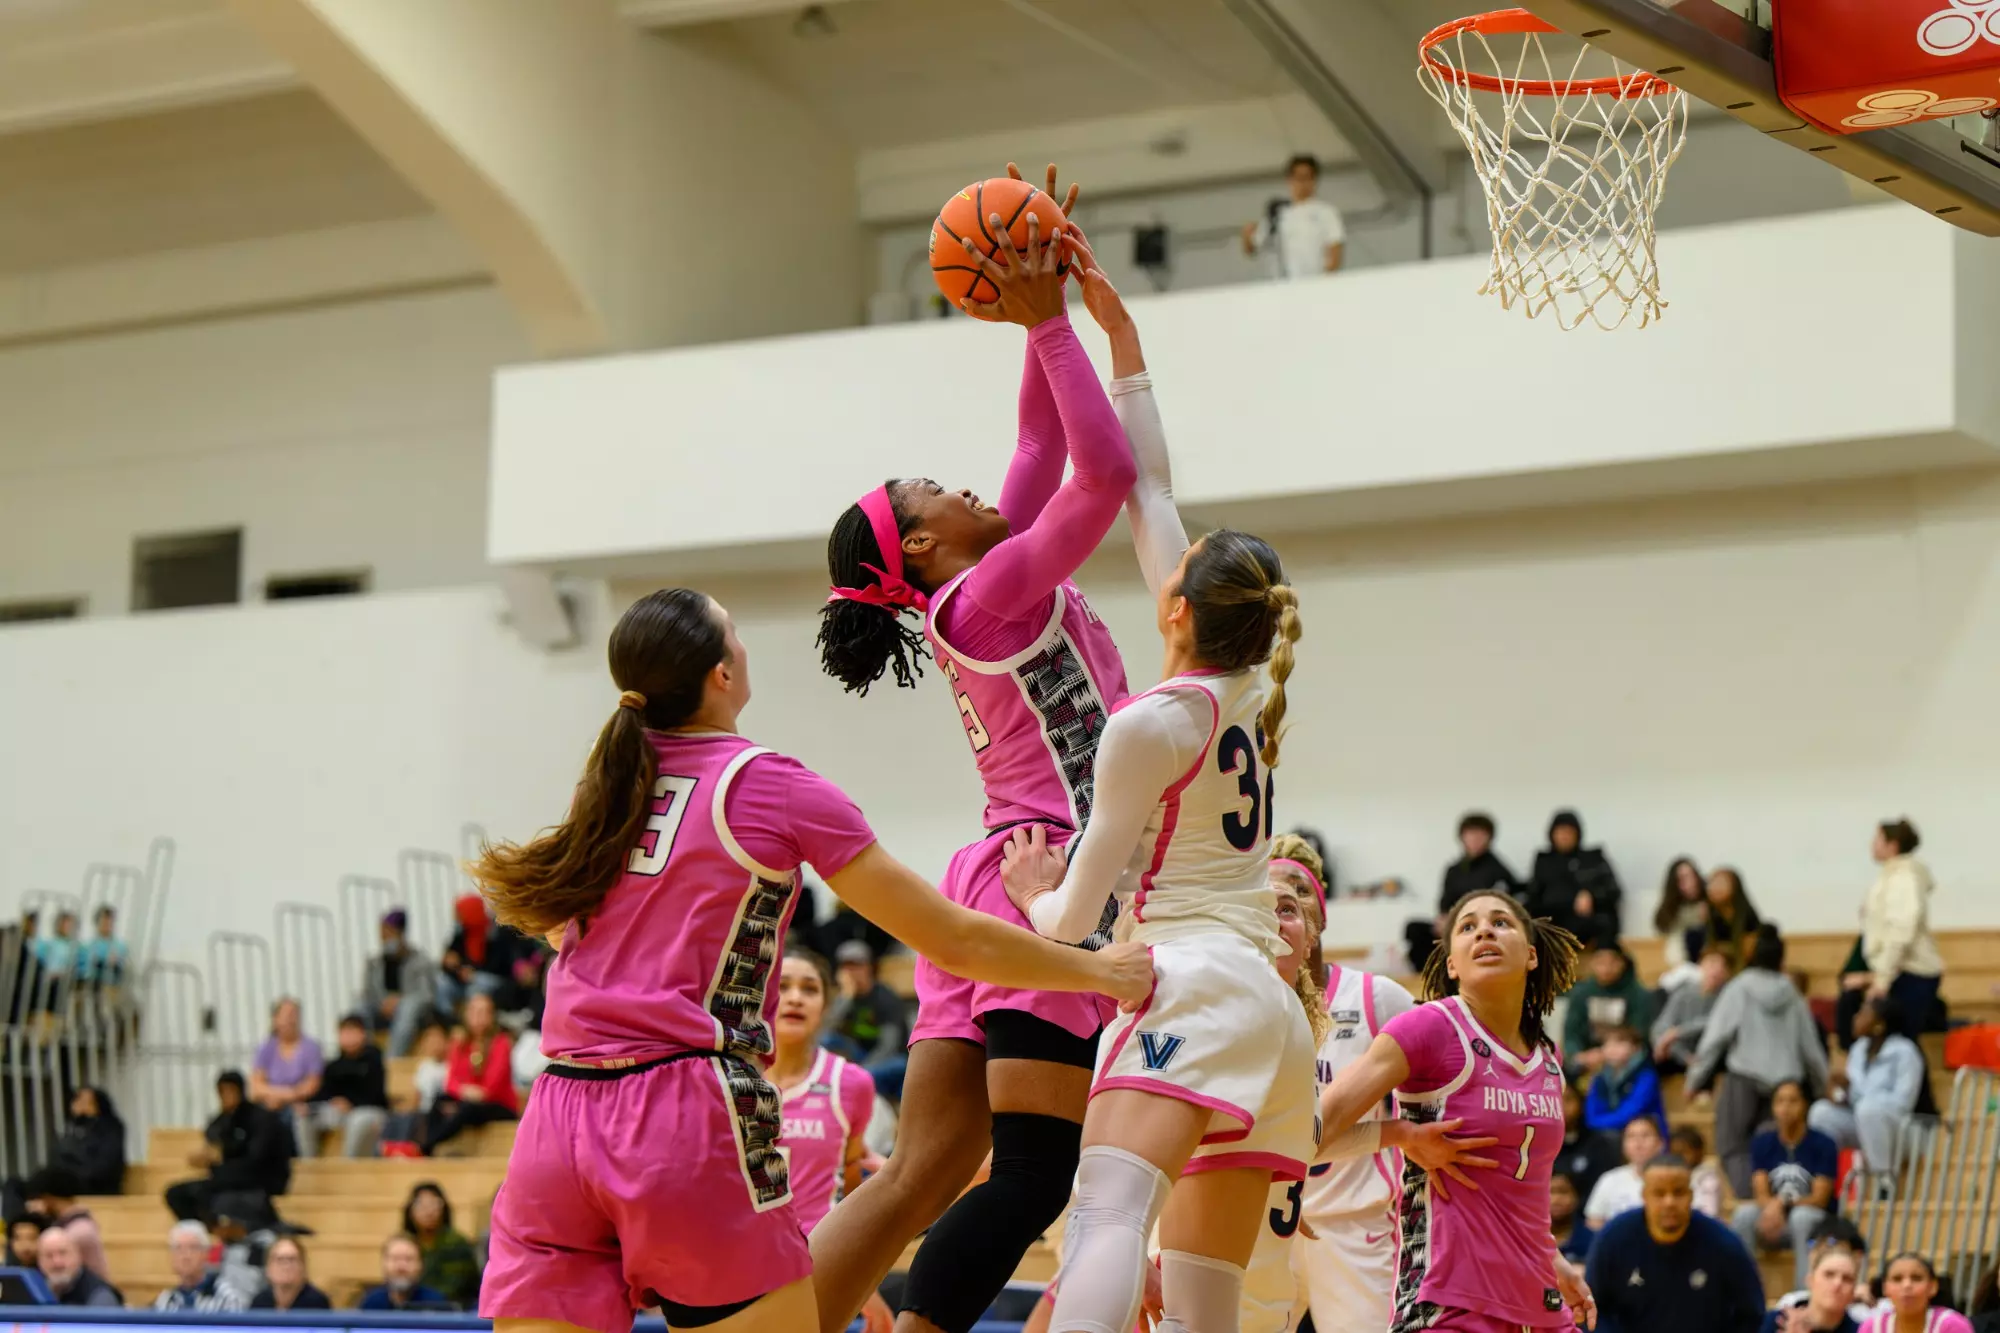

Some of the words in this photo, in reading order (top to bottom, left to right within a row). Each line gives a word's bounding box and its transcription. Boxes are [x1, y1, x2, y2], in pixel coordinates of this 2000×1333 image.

[625, 774, 700, 877] 3
[1136, 1030, 1186, 1073] V
[1483, 1086, 1527, 1116] HOYA
[1528, 1093, 1563, 1120] SAXA
[1513, 1124, 1536, 1181] 1
